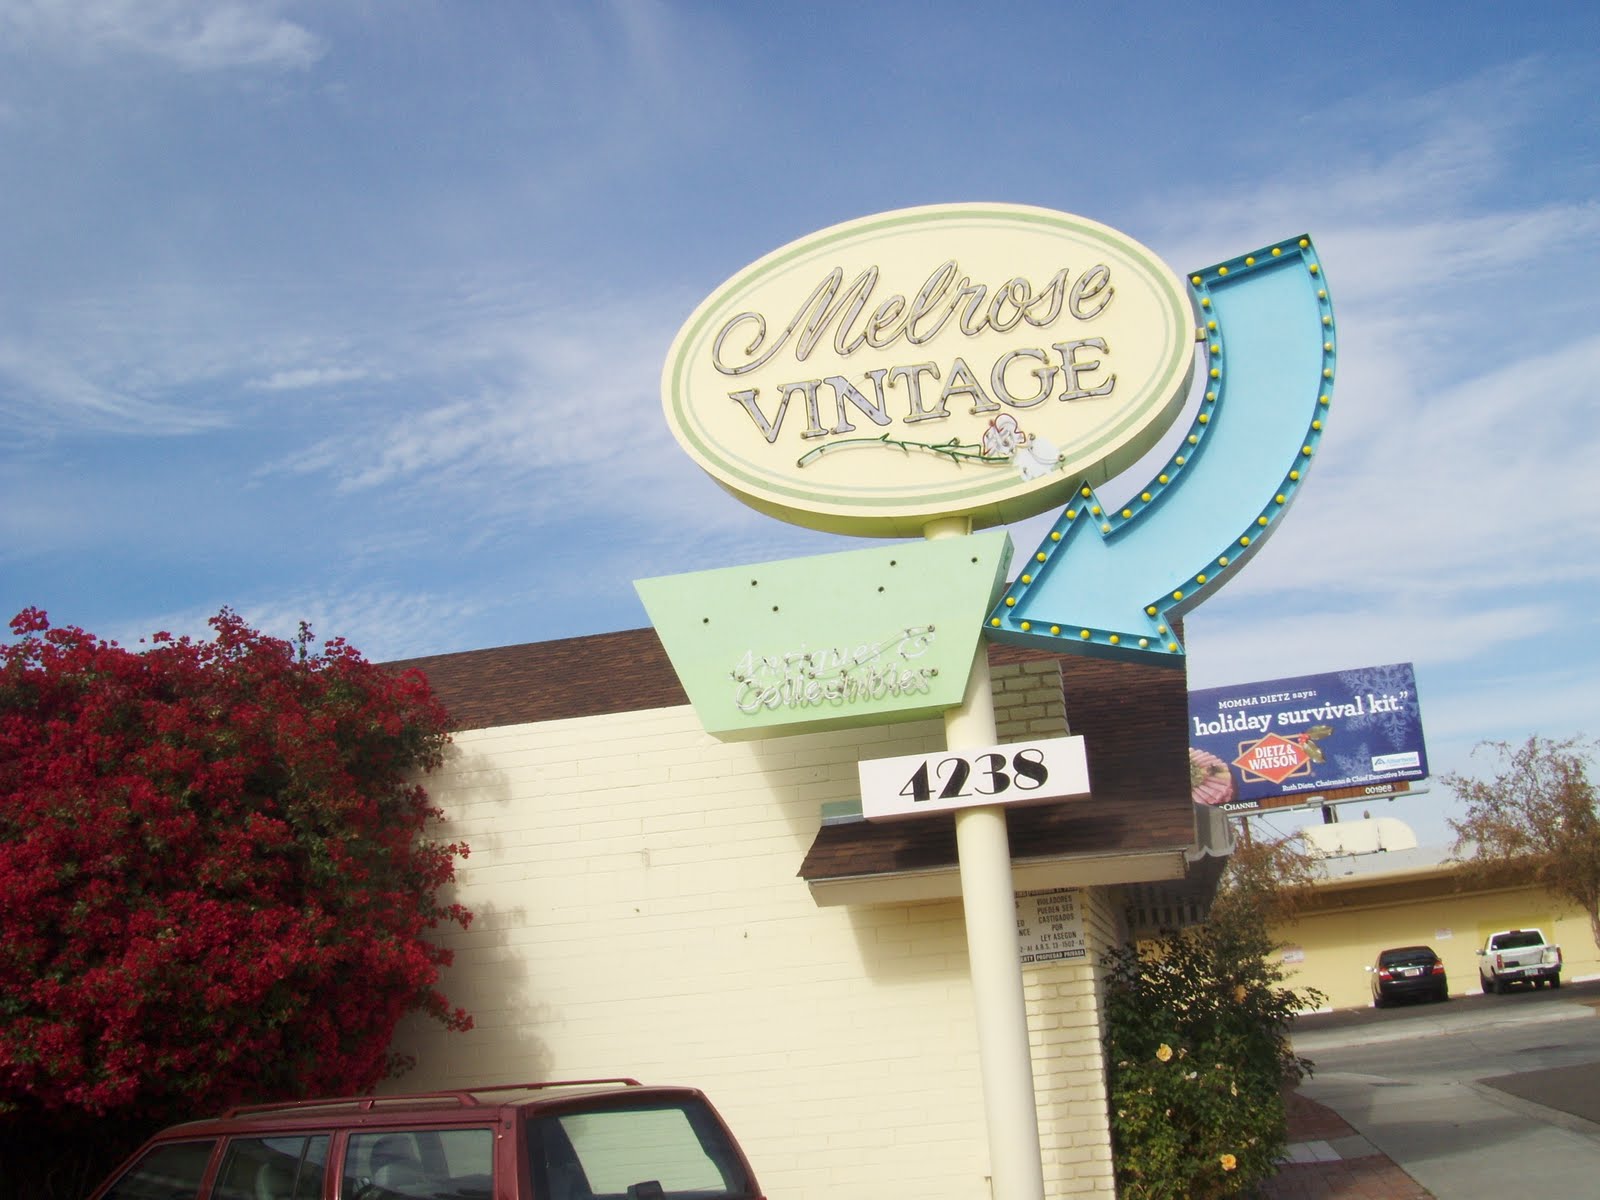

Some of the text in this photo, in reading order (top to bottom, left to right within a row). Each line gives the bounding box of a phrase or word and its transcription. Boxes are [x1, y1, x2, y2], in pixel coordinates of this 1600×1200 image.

[712, 259, 1115, 375] Melrose
[728, 337, 1116, 443] VINTAGE
[1218, 690, 1317, 709] MOMMA DIETZ says:
[1193, 710, 1272, 736] holiday
[1278, 695, 1364, 725] survival
[1255, 744, 1286, 759] DIETZ
[1248, 754, 1298, 770] WATSON
[899, 748, 1048, 802] 4238
[1282, 784, 1298, 792] Ruth
[1315, 779, 1345, 788] Chairman
[1061, 903, 1073, 912] SER
[1038, 913, 1074, 924] CASTIGADOS
[1052, 923, 1063, 931] POR
[1040, 934, 1051, 942] LEY
